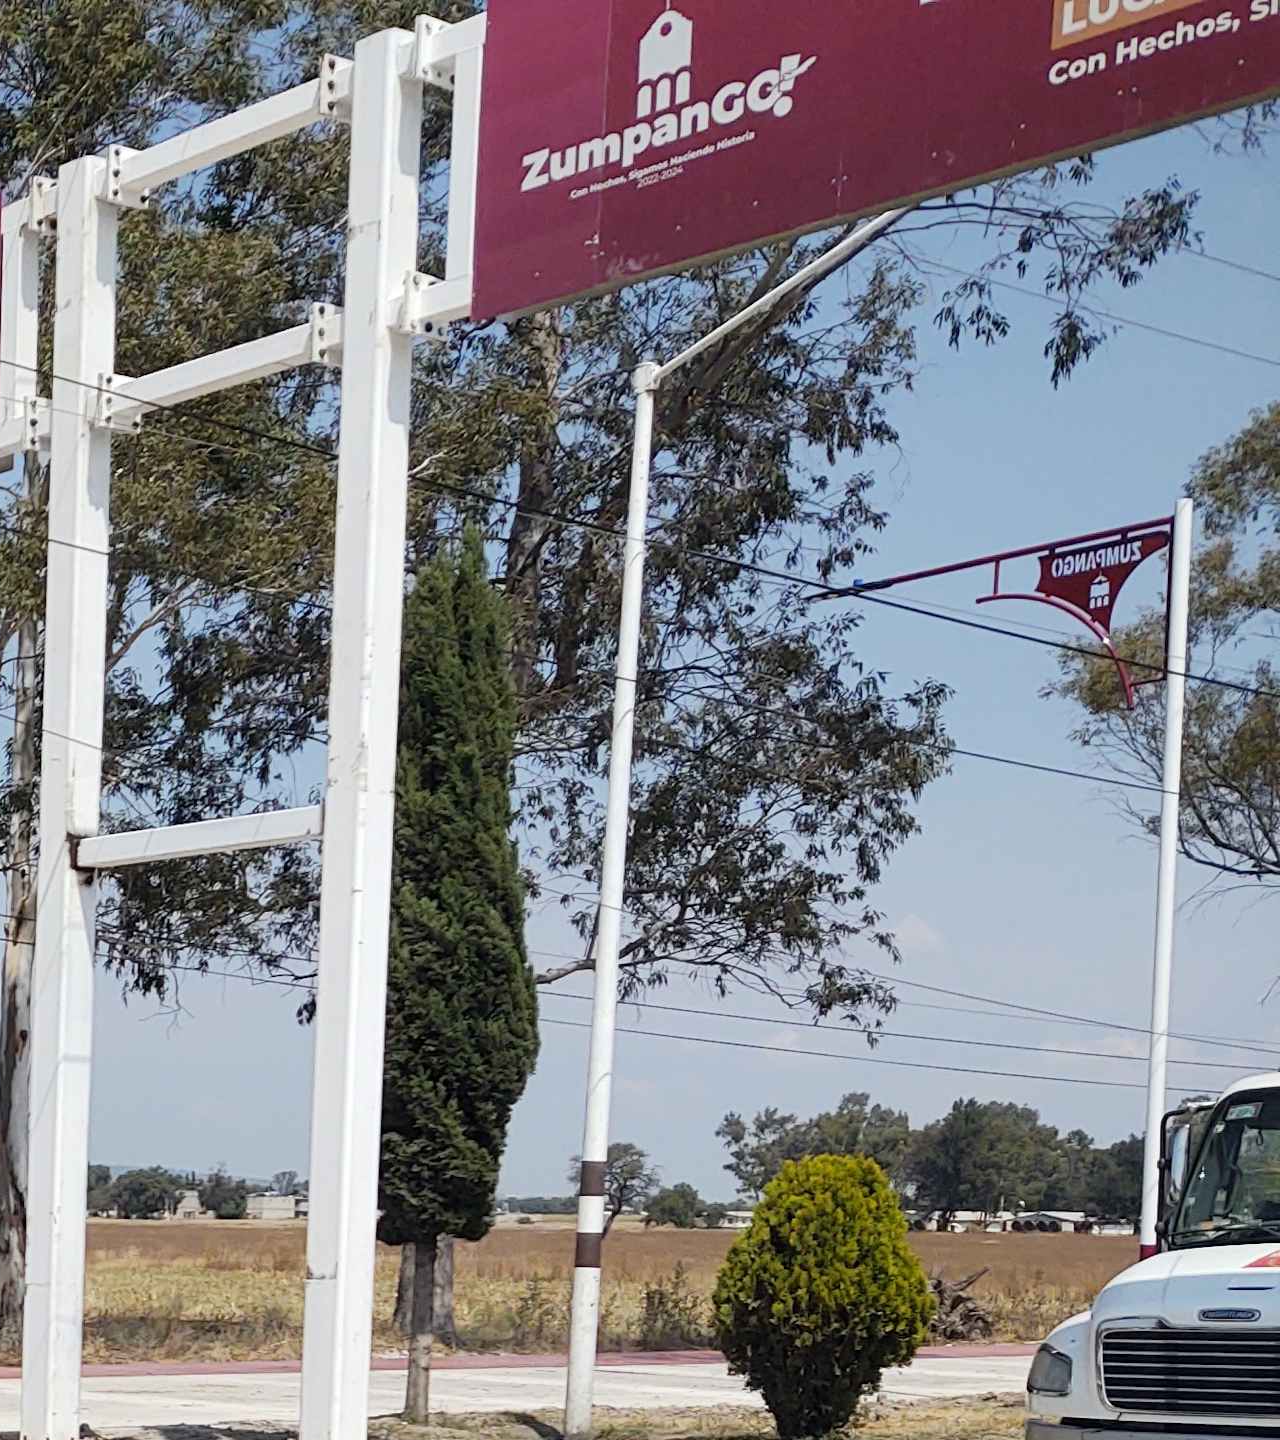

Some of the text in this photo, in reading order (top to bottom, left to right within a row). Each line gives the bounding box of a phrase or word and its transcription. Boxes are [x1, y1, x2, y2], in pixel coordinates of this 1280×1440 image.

[1047, 51, 1107, 86] Con
[1114, 11, 1241, 66] Hechos,
[569, 187, 589, 200] Con
